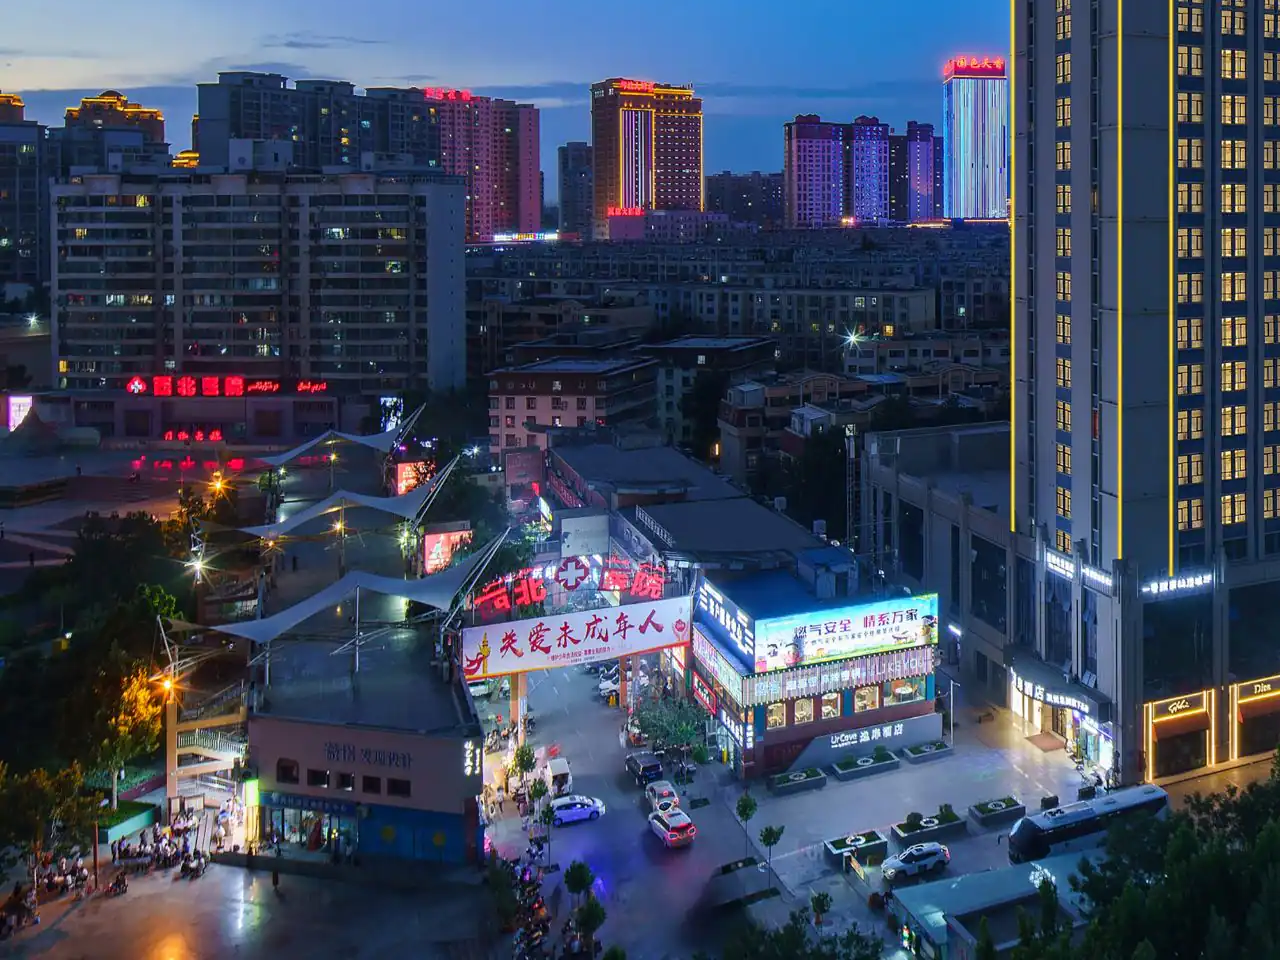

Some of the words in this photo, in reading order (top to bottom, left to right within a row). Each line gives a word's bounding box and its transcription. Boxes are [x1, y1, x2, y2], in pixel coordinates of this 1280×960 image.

[500, 609, 664, 658] 关爱未成年人
[794, 619, 851, 639] 燃气安全
[863, 608, 918, 628] 情系万家
